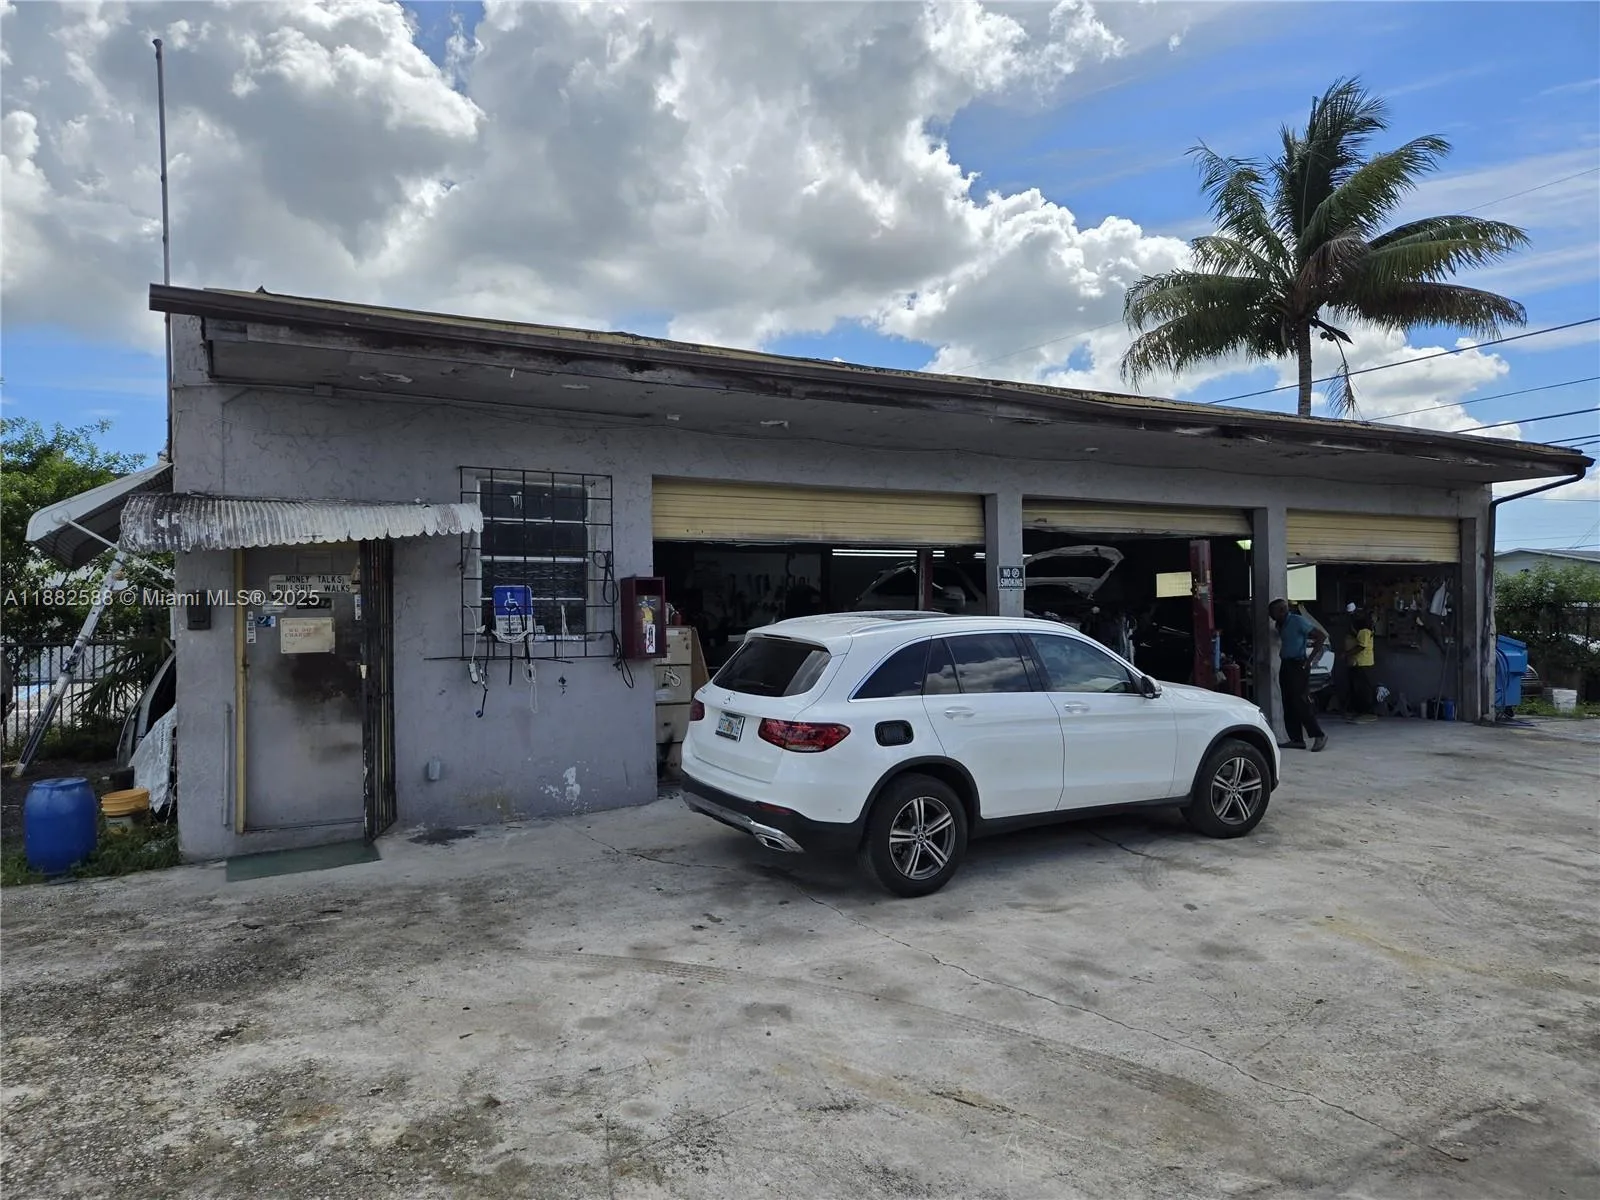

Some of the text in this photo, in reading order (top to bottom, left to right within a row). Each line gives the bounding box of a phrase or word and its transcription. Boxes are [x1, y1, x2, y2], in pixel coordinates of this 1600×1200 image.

[1003, 568, 1010, 578] NO
[285, 575, 310, 584] MONEY
[1000, 578, 1023, 587] SMOKING
[276, 584, 350, 593] BULLSHIT WALKS
